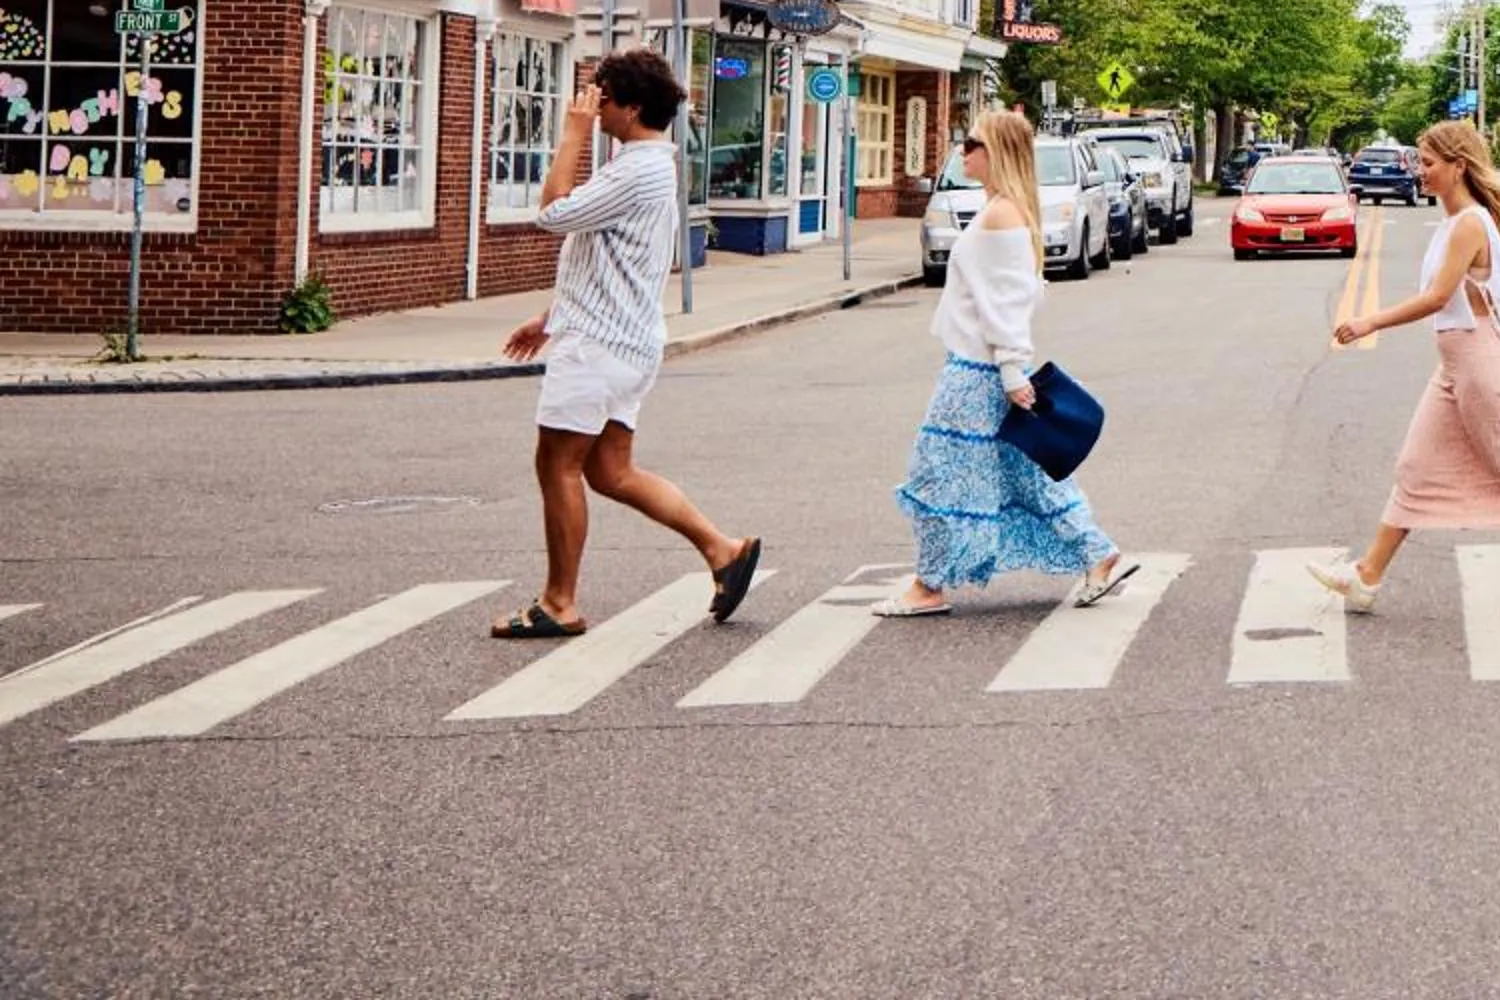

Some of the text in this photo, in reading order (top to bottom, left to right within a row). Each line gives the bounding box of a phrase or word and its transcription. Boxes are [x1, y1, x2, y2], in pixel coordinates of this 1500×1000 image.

[119, 13, 162, 30] FRONT
[1003, 23, 1060, 41] LIQUORS
[51, 143, 110, 182] DAY
